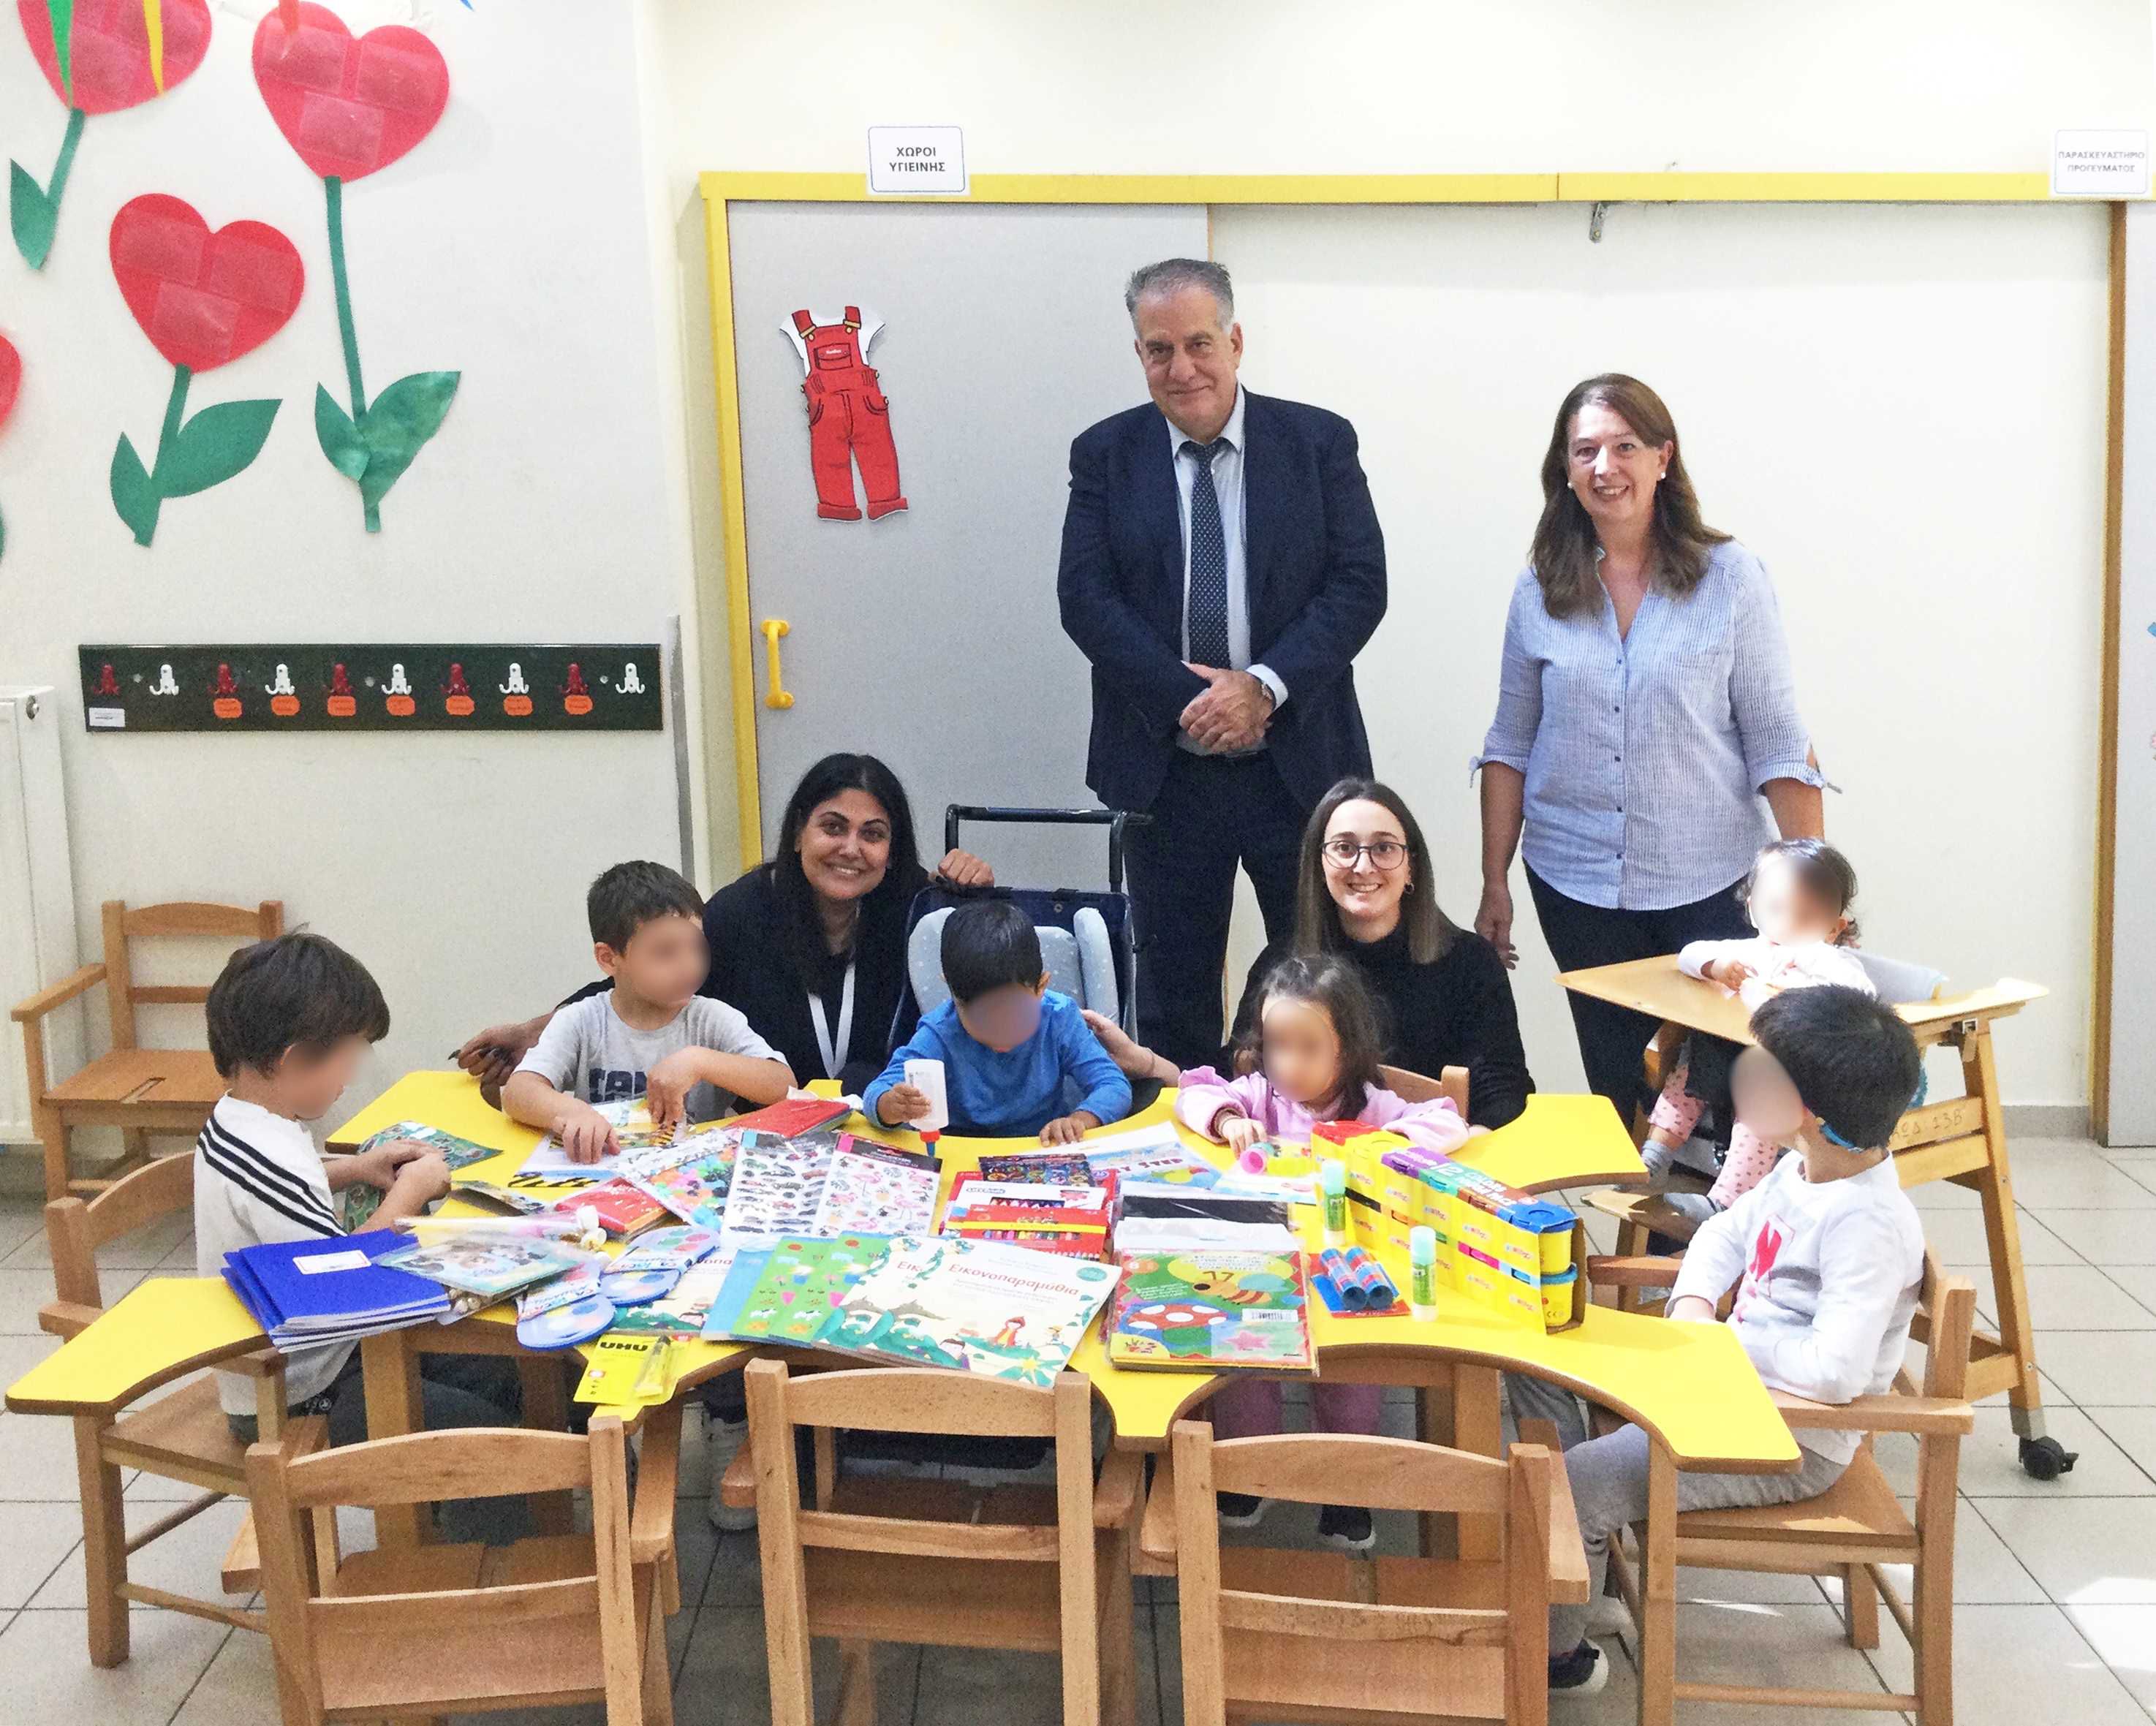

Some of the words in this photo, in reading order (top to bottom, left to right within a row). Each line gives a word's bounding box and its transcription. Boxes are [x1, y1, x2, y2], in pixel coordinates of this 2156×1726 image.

[896, 147, 937, 157] ΧΩΡΟΙ
[2057, 151, 2146, 159] ΠΑΡΑΣΚΕΥΑΣΤΗΡΙΟ
[889, 162, 946, 173] ΥΓΙΕΙΝΗΣ
[2067, 164, 2136, 173] ΠΡΟΓΕΥΜΑΤΟΣ
[599, 1341, 648, 1352] UHU
